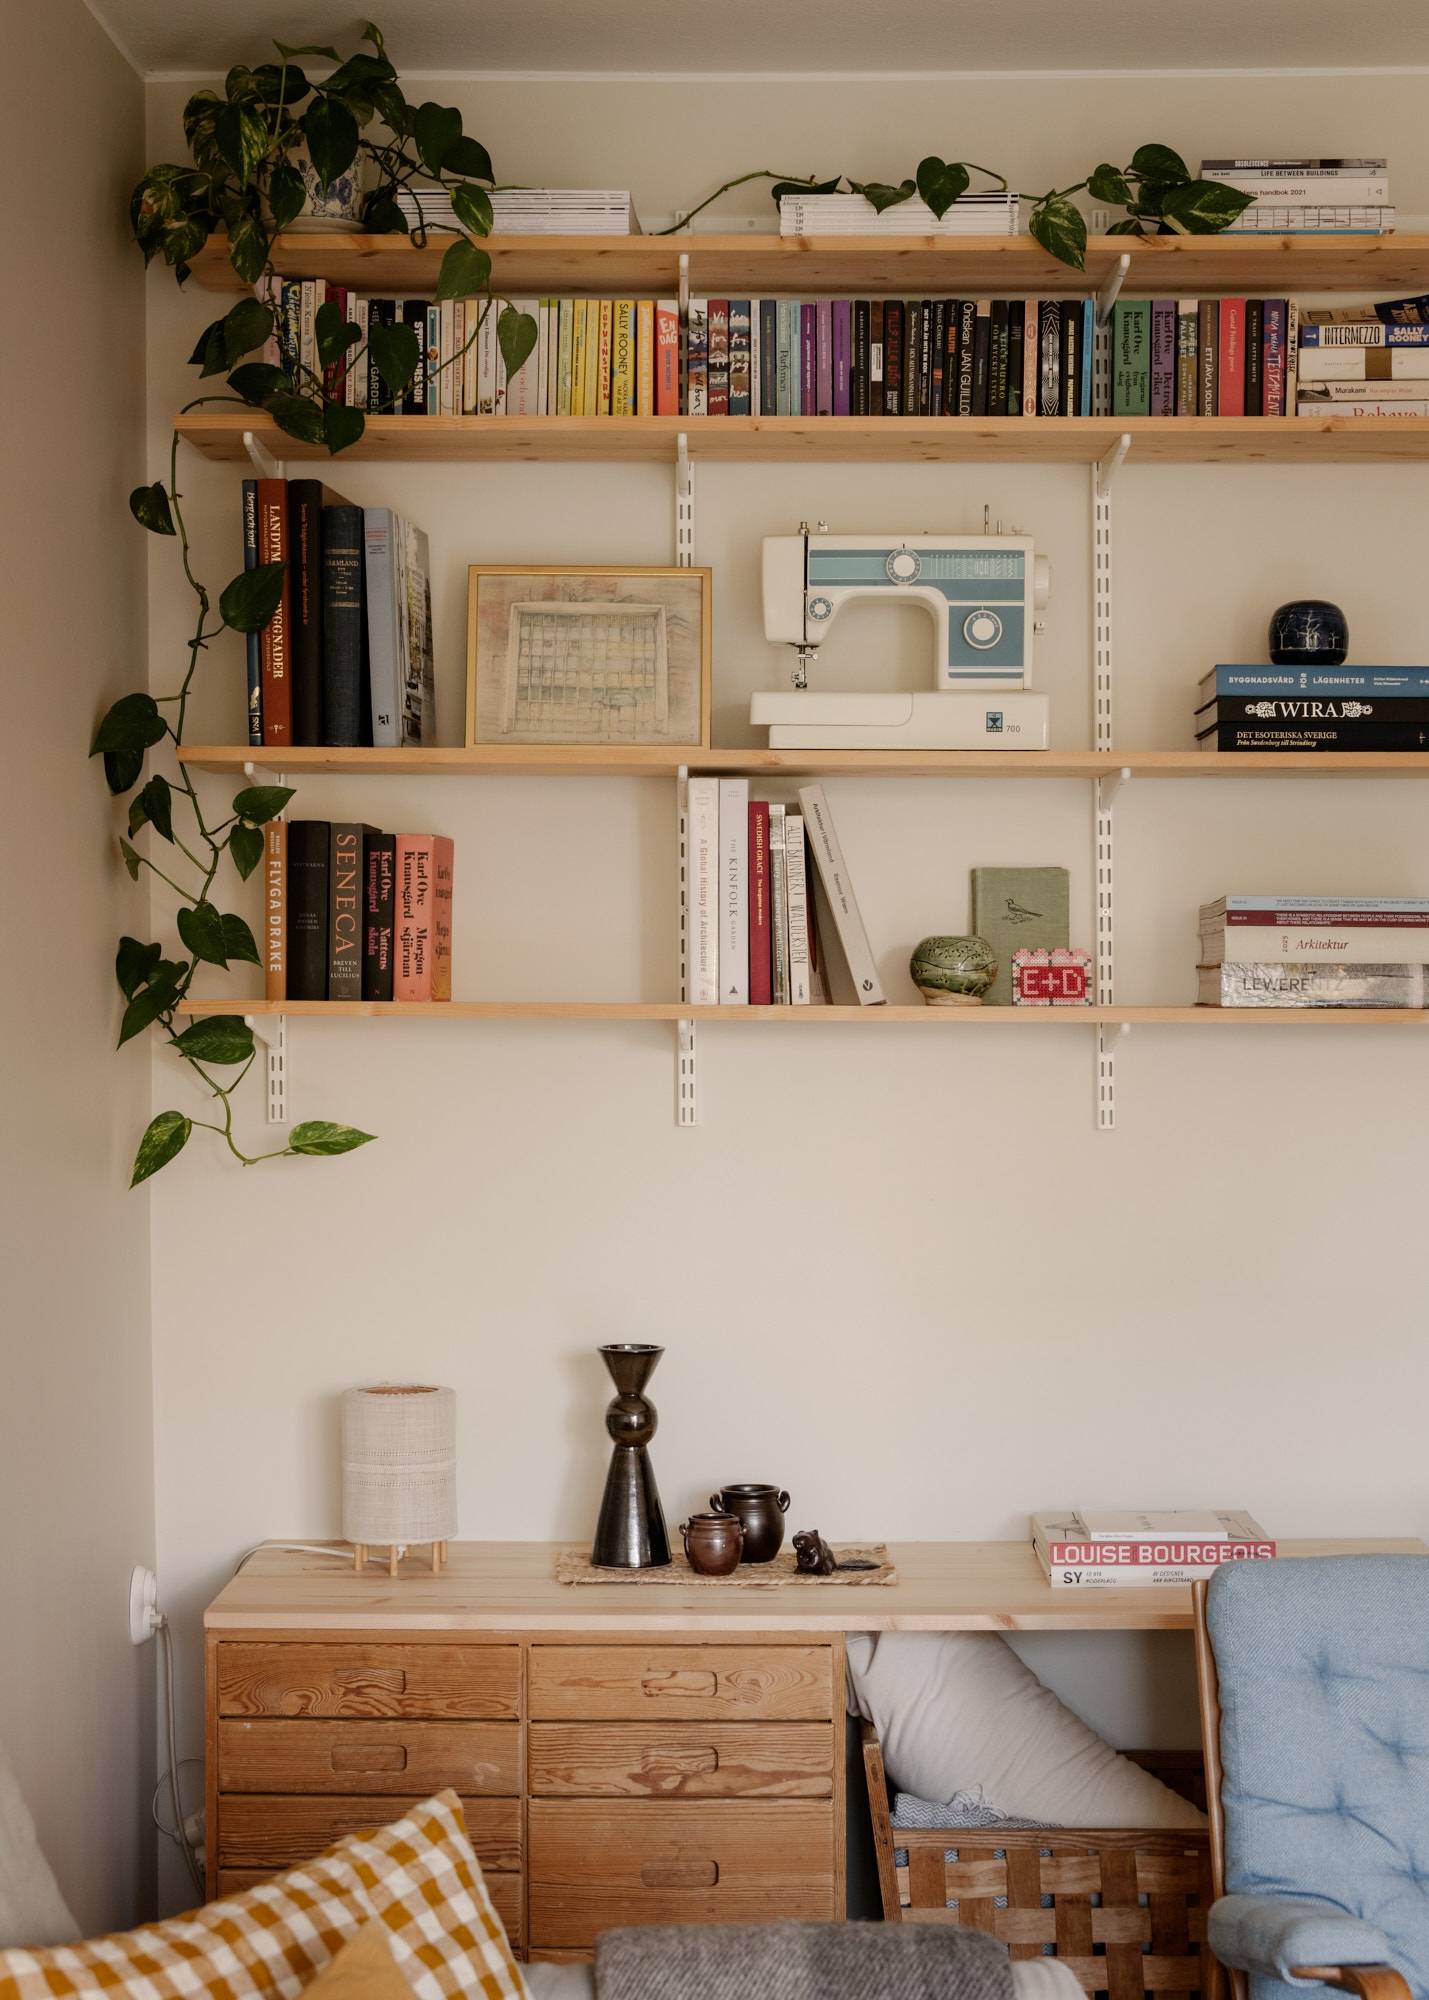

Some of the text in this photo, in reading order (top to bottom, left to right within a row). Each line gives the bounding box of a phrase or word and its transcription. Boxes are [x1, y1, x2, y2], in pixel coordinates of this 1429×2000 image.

[659, 317, 676, 331] EN
[713, 311, 724, 324] Vi
[963, 303, 974, 345] Ondskan
[1229, 309, 1237, 329] Gustaf
[1271, 310, 1279, 330] NINA
[618, 303, 629, 376] SALLY ROONEY
[659, 332, 677, 345] DAG
[923, 332, 930, 340] ÄR
[1121, 311, 1133, 365] Knausgård
[1133, 311, 1144, 354] Karl Ove
[1153, 311, 1164, 365] Knausgård
[1164, 311, 1173, 354] Karl Ove
[1188, 322, 1196, 357] PAPPERS
[1324, 326, 1425, 345] INTERMEZZO SALLY
[1388, 334, 1429, 342] ROONEY
[779, 350, 789, 392] Parfymen
[923, 353, 928, 361] EN
[961, 349, 972, 371] JAN
[991, 324, 999, 406] FÖR MYCKET LYCKA
[999, 332, 1008, 399] ALICE MUNRO
[413, 355, 423, 403] ARSSON
[1139, 371, 1147, 403] Vargarna
[1153, 372, 1163, 395] riket
[1163, 372, 1172, 389] Det
[1204, 347, 1214, 416] ETT JÄVLA SOLSKE
[246, 492, 256, 548] Berg och jord
[1228, 675, 1294, 684] BYGGNADSVÅRD
[1299, 673, 1307, 688] FÖR
[1312, 675, 1365, 684] LÄGENHETER
[1280, 701, 1339, 718] WIRA
[251, 716, 260, 733] SNA
[1006, 725, 1021, 733] 700
[1254, 731, 1303, 739] ESOTERISKA
[1303, 732, 1338, 740] SVERIGE
[1250, 739, 1280, 747] Swedenborg
[1289, 739, 1317, 748] Strindberg
[756, 814, 764, 848] SWEDISH
[788, 825, 803, 845] ALLT
[813, 803, 825, 830] Arkitektur
[821, 835, 835, 863] Värmland
[700, 847, 709, 874] Global
[756, 850, 764, 874] GRACE
[774, 855, 783, 879] Theory
[368, 851, 380, 912] Knausgård
[381, 851, 392, 901] Karl Ove
[402, 851, 415, 919] Knausgård
[417, 851, 429, 905] Karl Ove
[729, 857, 738, 917] KINFOLK
[335, 834, 357, 954] SENECA
[698, 877, 709, 906] History
[270, 861, 282, 972] FLYGA DRAKE
[700, 910, 709, 918] of
[774, 890, 784, 927] Landscape
[368, 927, 379, 955] skola
[380, 927, 391, 970] Nattens
[700, 921, 709, 973] Architecture
[791, 904, 808, 964] WALDERSTEN
[1295, 938, 1349, 951] Arkitektur
[400, 927, 414, 977] stjärnan
[775, 929, 785, 973] Architecture
[1022, 969, 1082, 995] E+D
[1242, 977, 1343, 992] LEWERENTZ
[1053, 1544, 1272, 1564] LOUISE BOURGEOIS
[1063, 1572, 1083, 1585] SY
